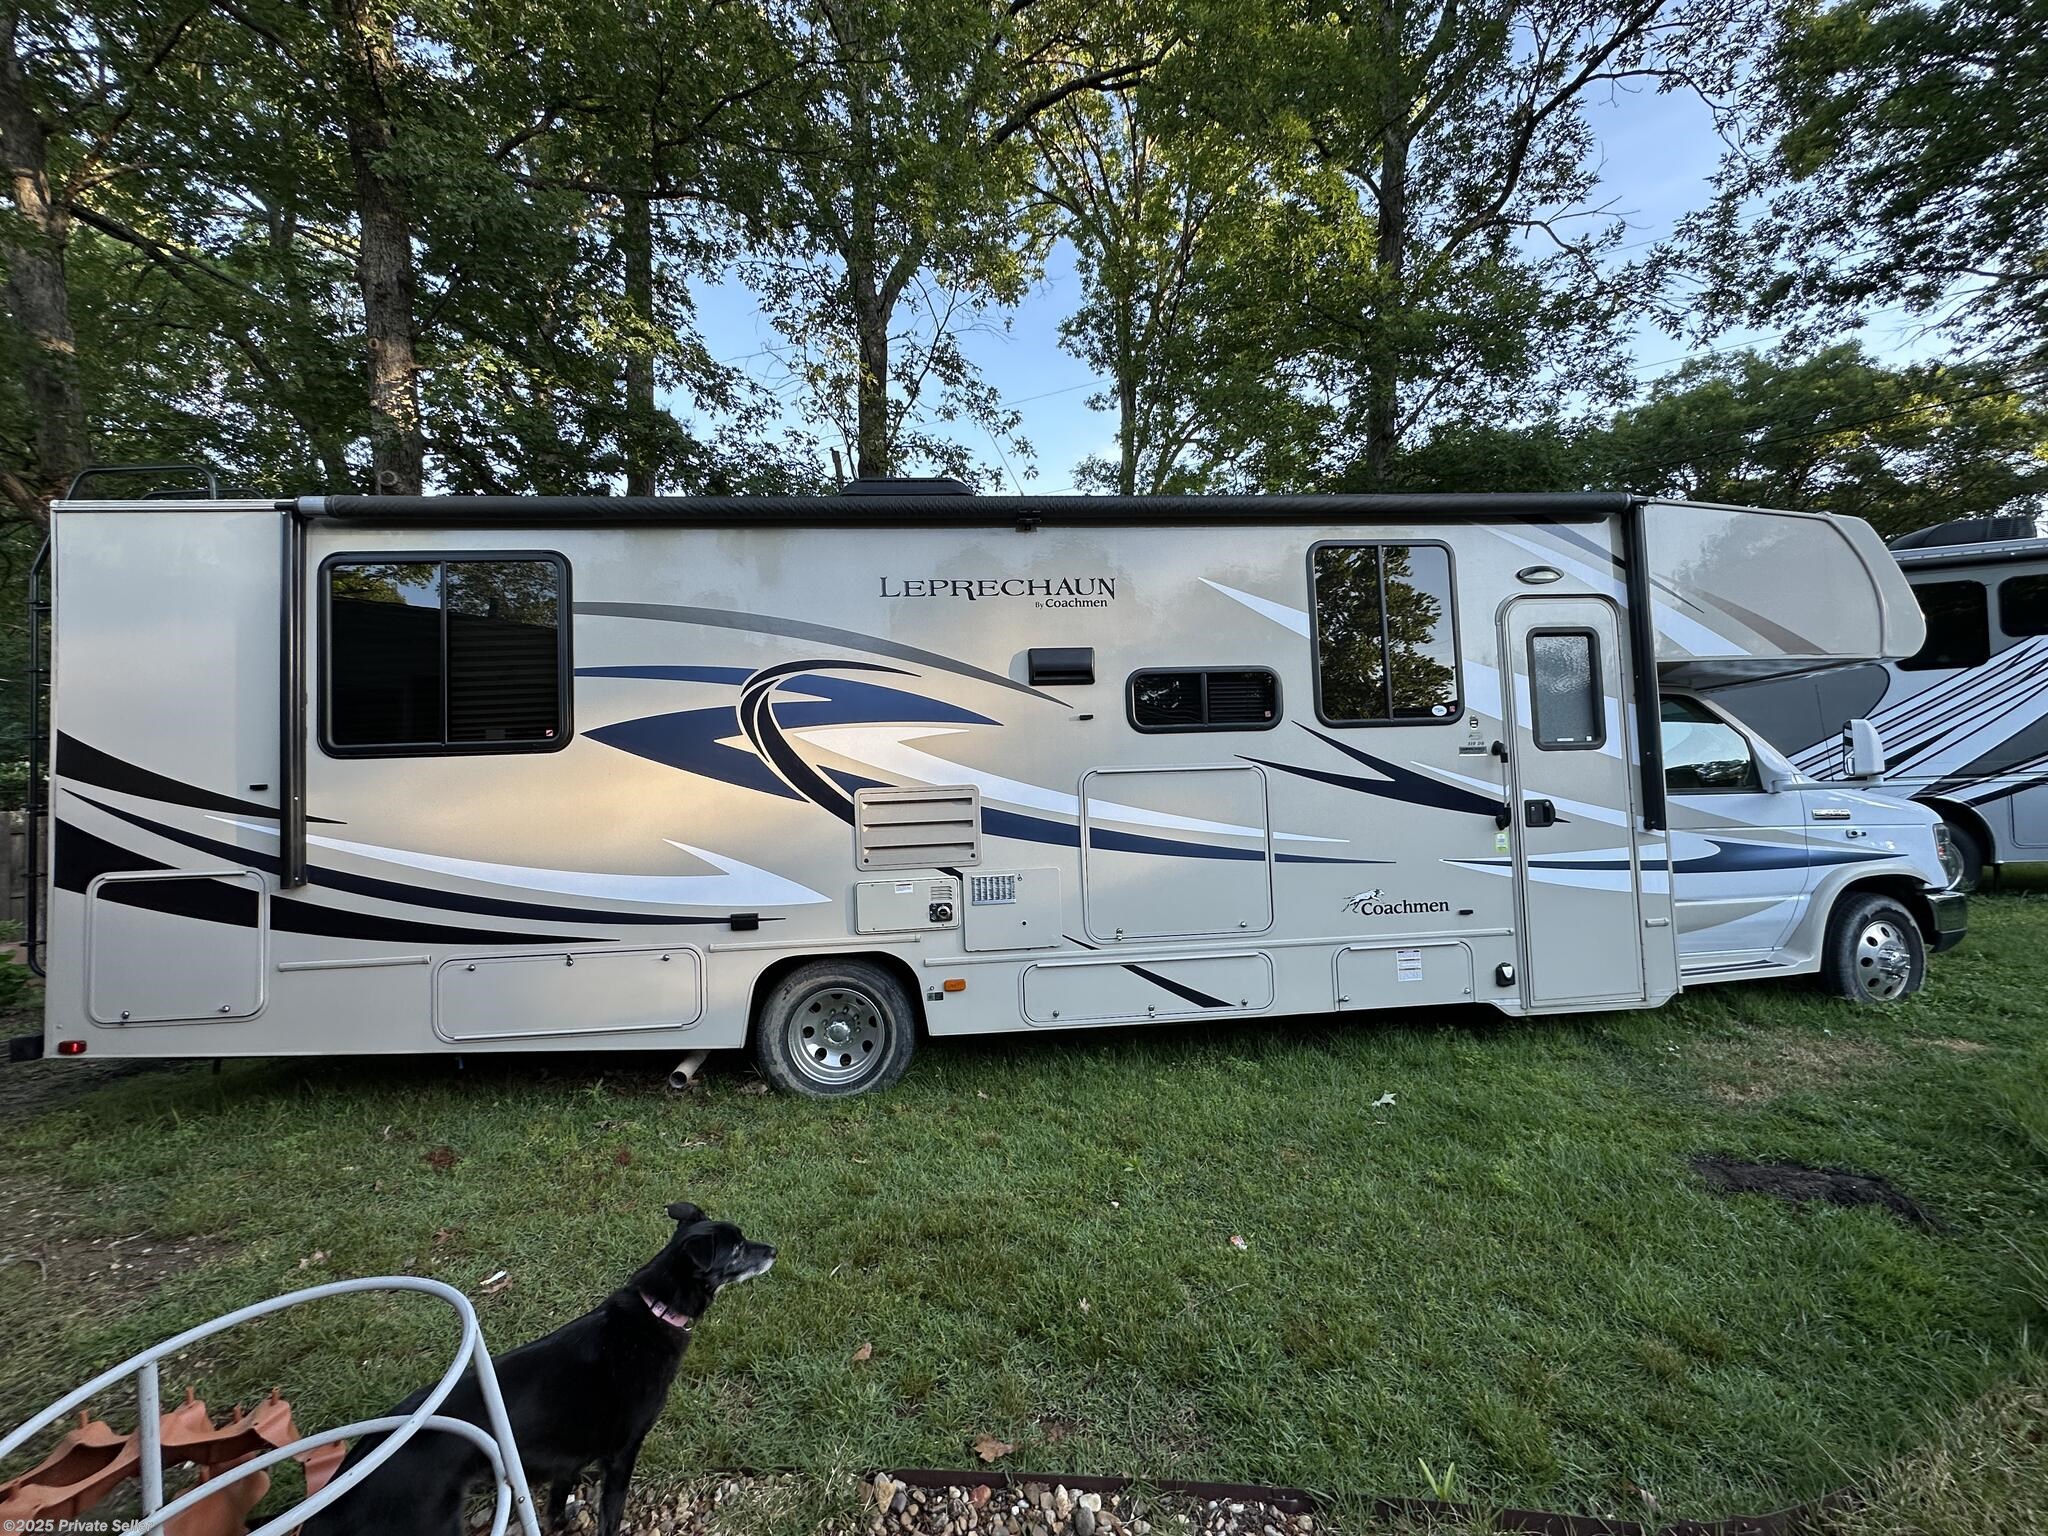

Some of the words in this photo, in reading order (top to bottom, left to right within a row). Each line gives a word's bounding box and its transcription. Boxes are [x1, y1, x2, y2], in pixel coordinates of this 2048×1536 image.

[879, 576, 1116, 600] LEPRECHAUN
[1035, 601, 1043, 610] By
[1045, 598, 1108, 608] Coachmen
[1361, 900, 1450, 916] Coachmen
